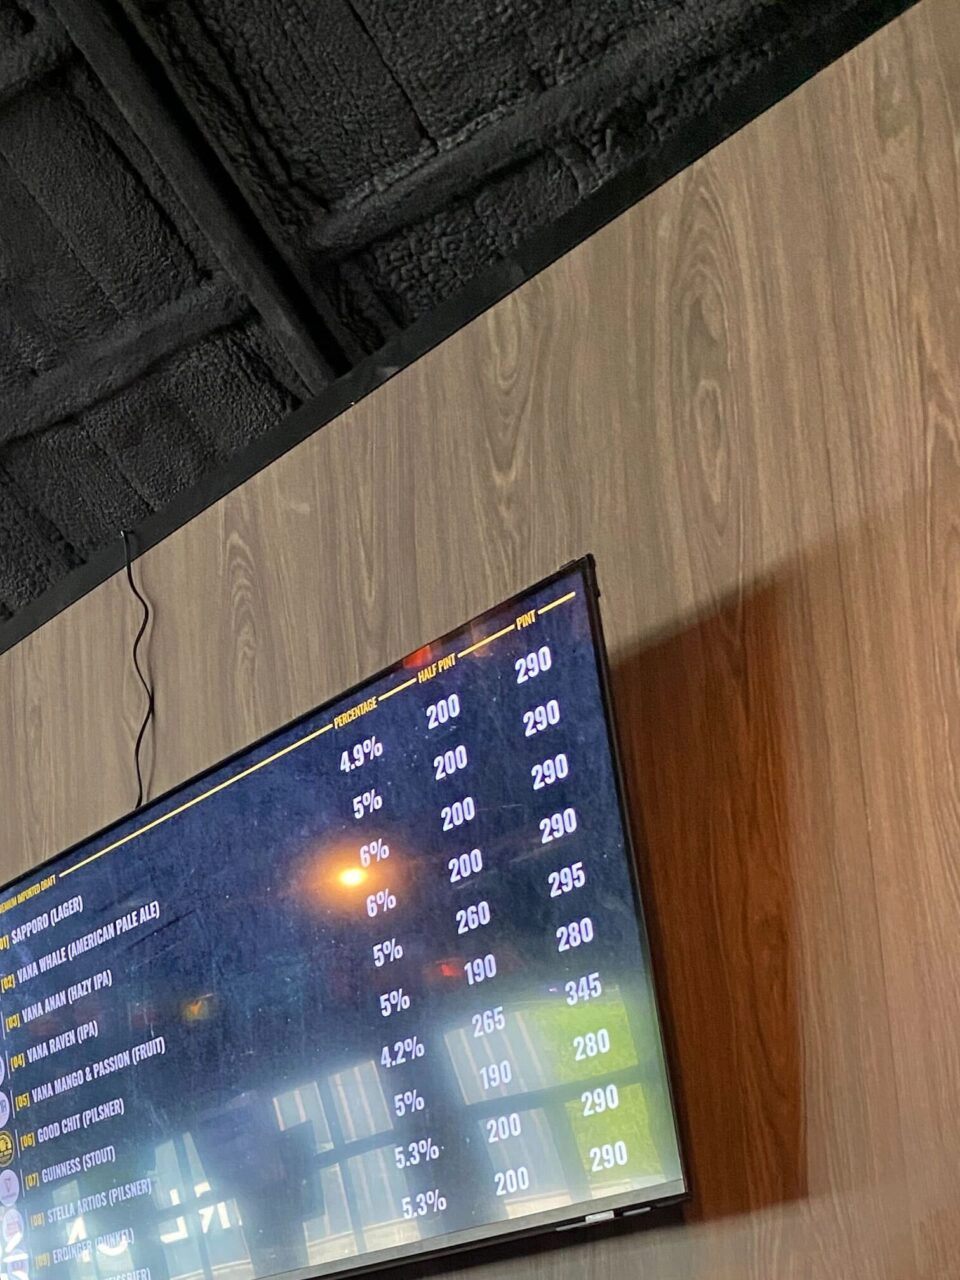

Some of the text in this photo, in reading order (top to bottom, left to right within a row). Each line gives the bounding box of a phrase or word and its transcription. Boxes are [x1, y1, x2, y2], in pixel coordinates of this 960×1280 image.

[516, 609, 536, 631] PINT
[417, 653, 456, 684] HALF PINT
[515, 646, 552, 684] 290
[333, 696, 378, 729] PERCENTAGE
[426, 693, 461, 730] 200
[523, 700, 560, 737] 290
[340, 735, 384, 773] 4.9%
[433, 745, 468, 780] 200
[531, 753, 569, 791] 290
[353, 789, 383, 819] 5%
[441, 796, 475, 831] 200
[539, 807, 577, 845] 290
[359, 838, 390, 868] 6%
[448, 848, 483, 883] 200
[40, 874, 56, 893] DRAFT
[548, 861, 586, 898] 295
[11, 911, 49, 945] SAPPORO
[50, 895, 84, 928] (LAGER)
[366, 888, 397, 918] 6%
[456, 900, 490, 934] 260
[16, 961, 39, 984] VANA
[39, 947, 67, 973] WHALE
[67, 924, 116, 962] (AMERICAN
[116, 912, 139, 936] PALE
[139, 900, 160, 925] ALE)
[556, 916, 594, 952] 280
[373, 938, 404, 967] 5%
[464, 953, 497, 985] 190
[21, 1000, 44, 1023] VANA
[44, 990, 67, 1013] ANAN
[67, 977, 92, 1005] (HAZY
[93, 969, 113, 991] IPA)
[380, 987, 410, 1017] 5%
[565, 971, 603, 1006] 345
[472, 1006, 506, 1037] 265
[26, 1041, 49, 1063] VANA
[49, 1029, 76, 1053] RAVEN
[77, 1020, 99, 1044] (IPA)
[380, 1035, 425, 1068] 4.2%
[573, 1027, 611, 1061] 280
[15, 1092, 30, 1111] [05]
[31, 1082, 54, 1103] VANA
[54, 1069, 85, 1094] MANGO
[85, 1067, 93, 1083] &
[93, 1050, 131, 1079] PASSION
[131, 1036, 166, 1065] (FRUIT)
[480, 1059, 513, 1090] 190
[394, 1088, 425, 1117] 5%
[581, 1083, 620, 1117] 290
[20, 1097, 125, 1151] [06] GOOD CHIT (PILSNER)
[487, 1112, 522, 1143] 200
[41, 1159, 81, 1183] GUINNESS
[82, 1145, 116, 1172] (STOUT)
[394, 1138, 440, 1169] 5.3%
[590, 1139, 628, 1173] 290
[495, 1165, 530, 1196] 200
[47, 1178, 152, 1223] STELLA ARTIOS (PILSNER)
[401, 1189, 447, 1220] 5.3%
[52, 1240, 91, 1264] ERDINGER
